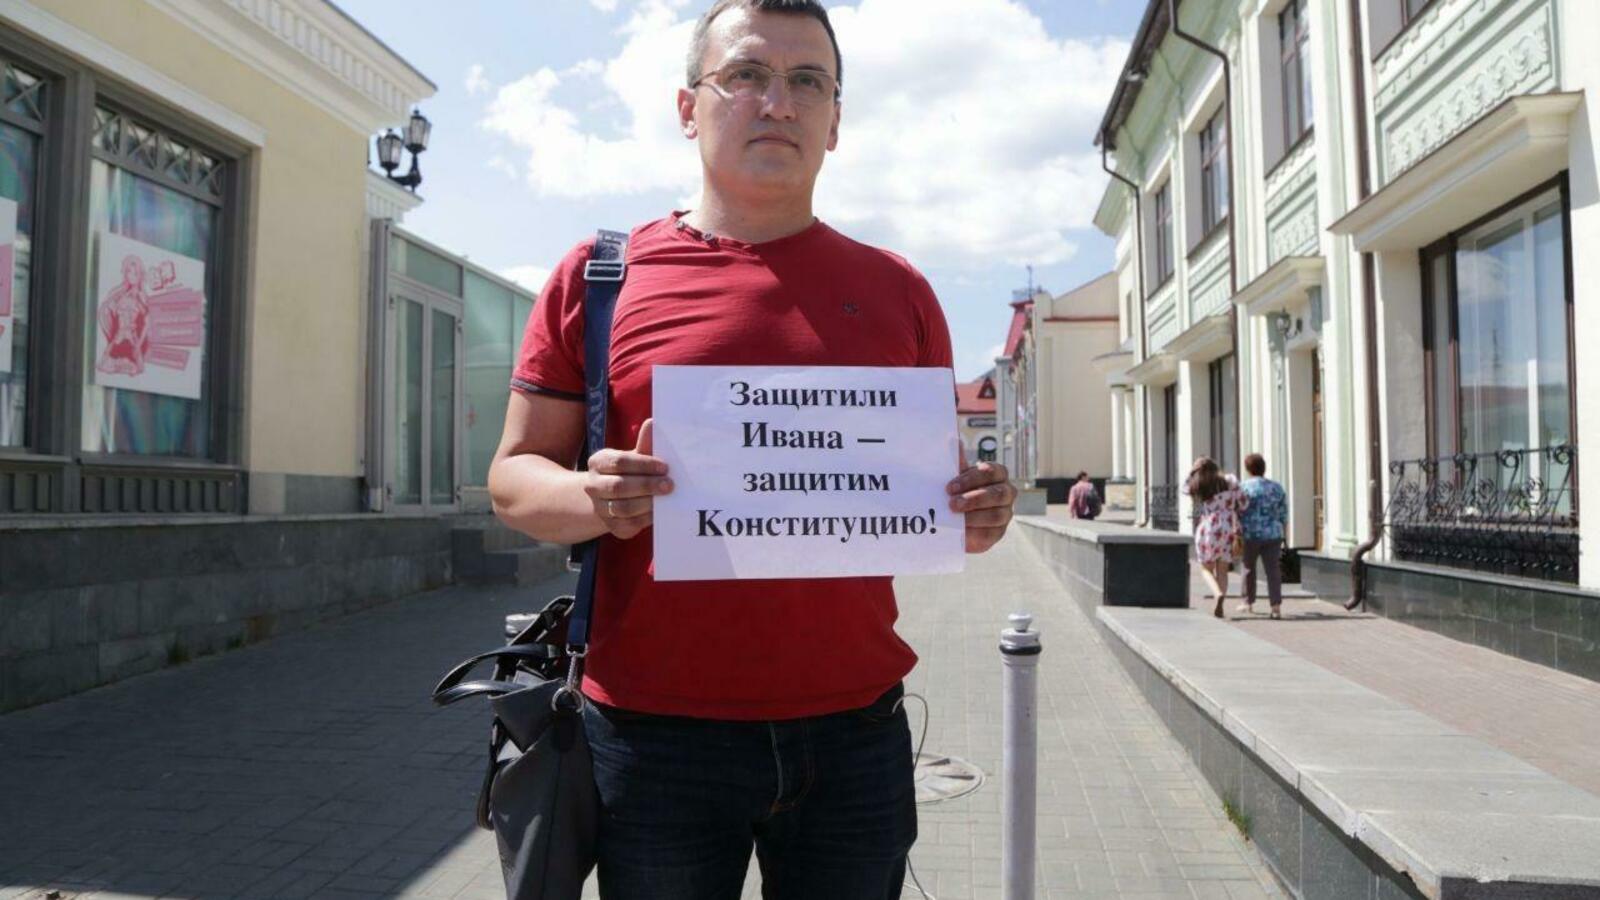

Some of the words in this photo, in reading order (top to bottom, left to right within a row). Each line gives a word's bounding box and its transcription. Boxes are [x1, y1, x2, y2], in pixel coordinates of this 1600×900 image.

[729, 381, 897, 410] Защитили
[741, 421, 845, 450] Ивана
[742, 472, 891, 496] защитим
[696, 507, 937, 543] Конституцию!
